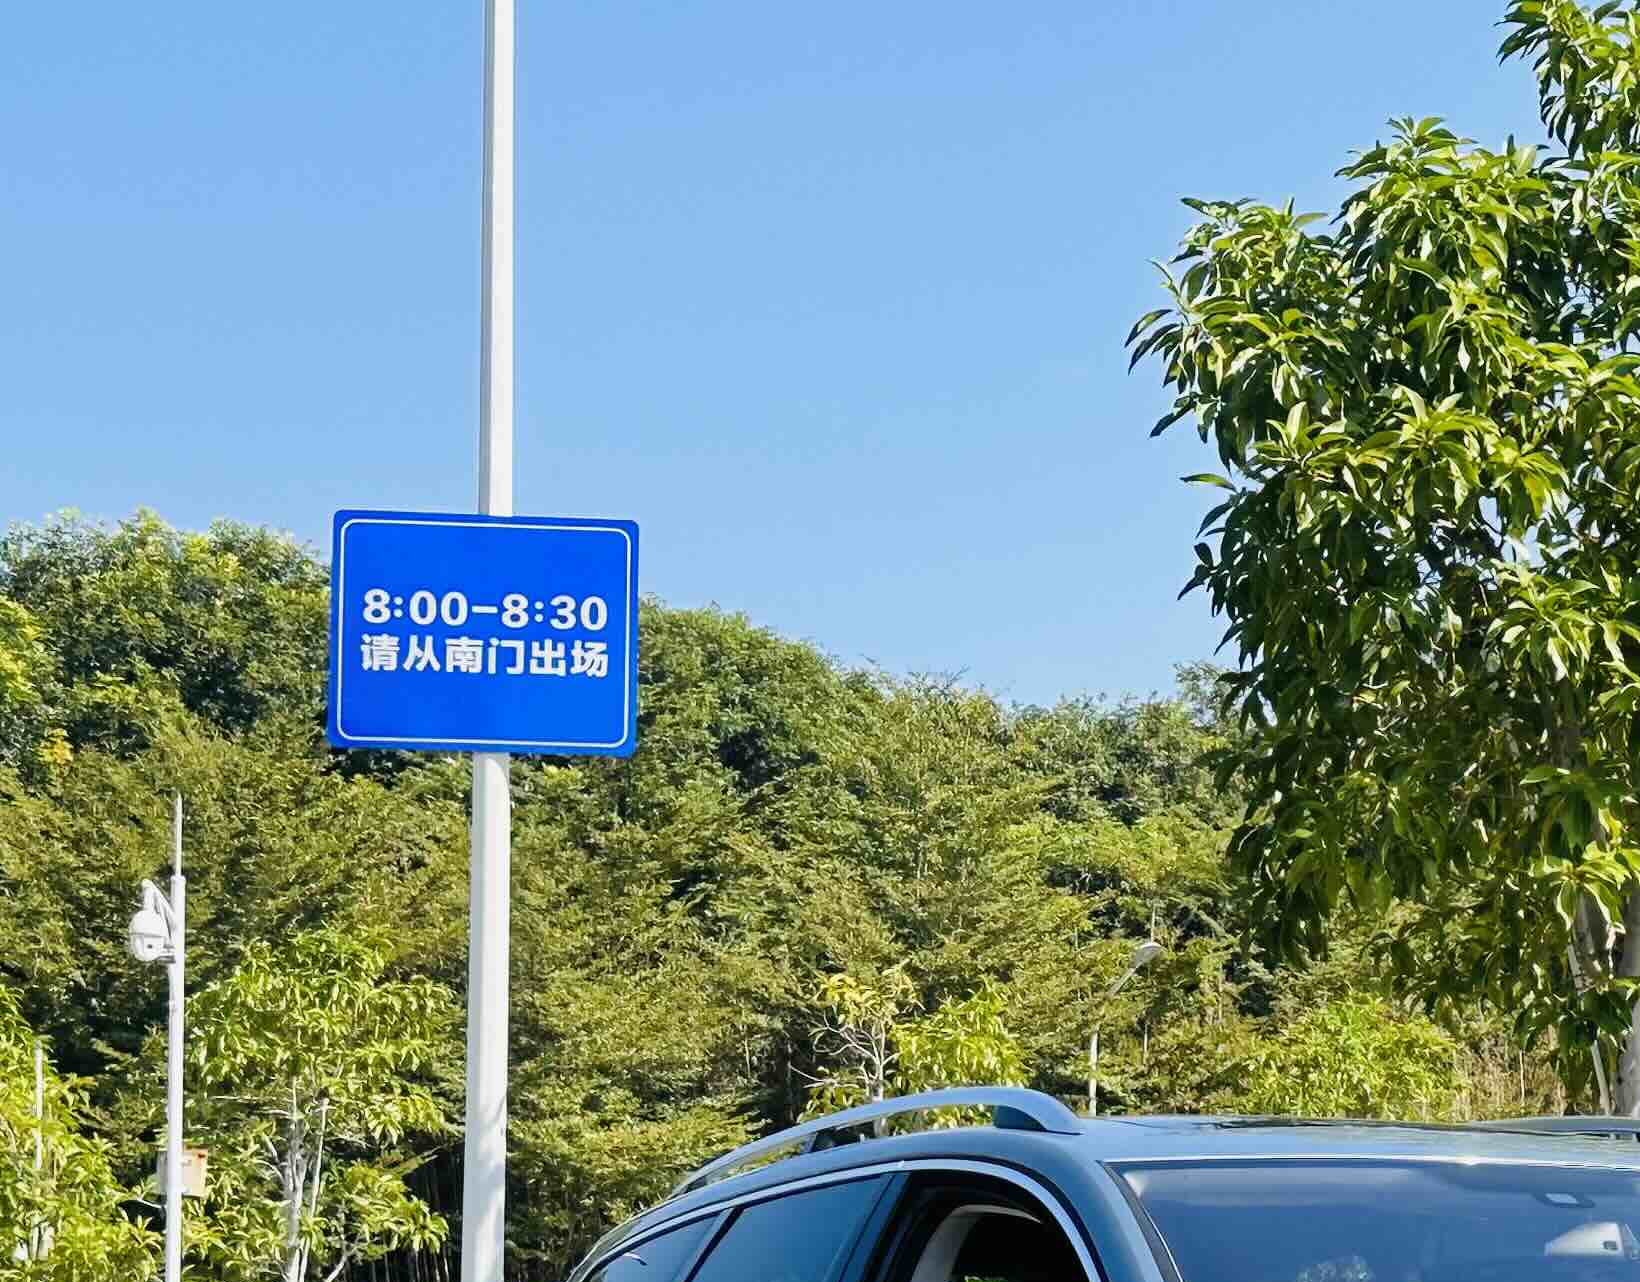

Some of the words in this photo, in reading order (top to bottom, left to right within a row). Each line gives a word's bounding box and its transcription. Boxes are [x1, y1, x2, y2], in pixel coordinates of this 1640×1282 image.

[361, 588, 609, 631] 8:00-8:30
[359, 632, 609, 678] 请从南门出场
